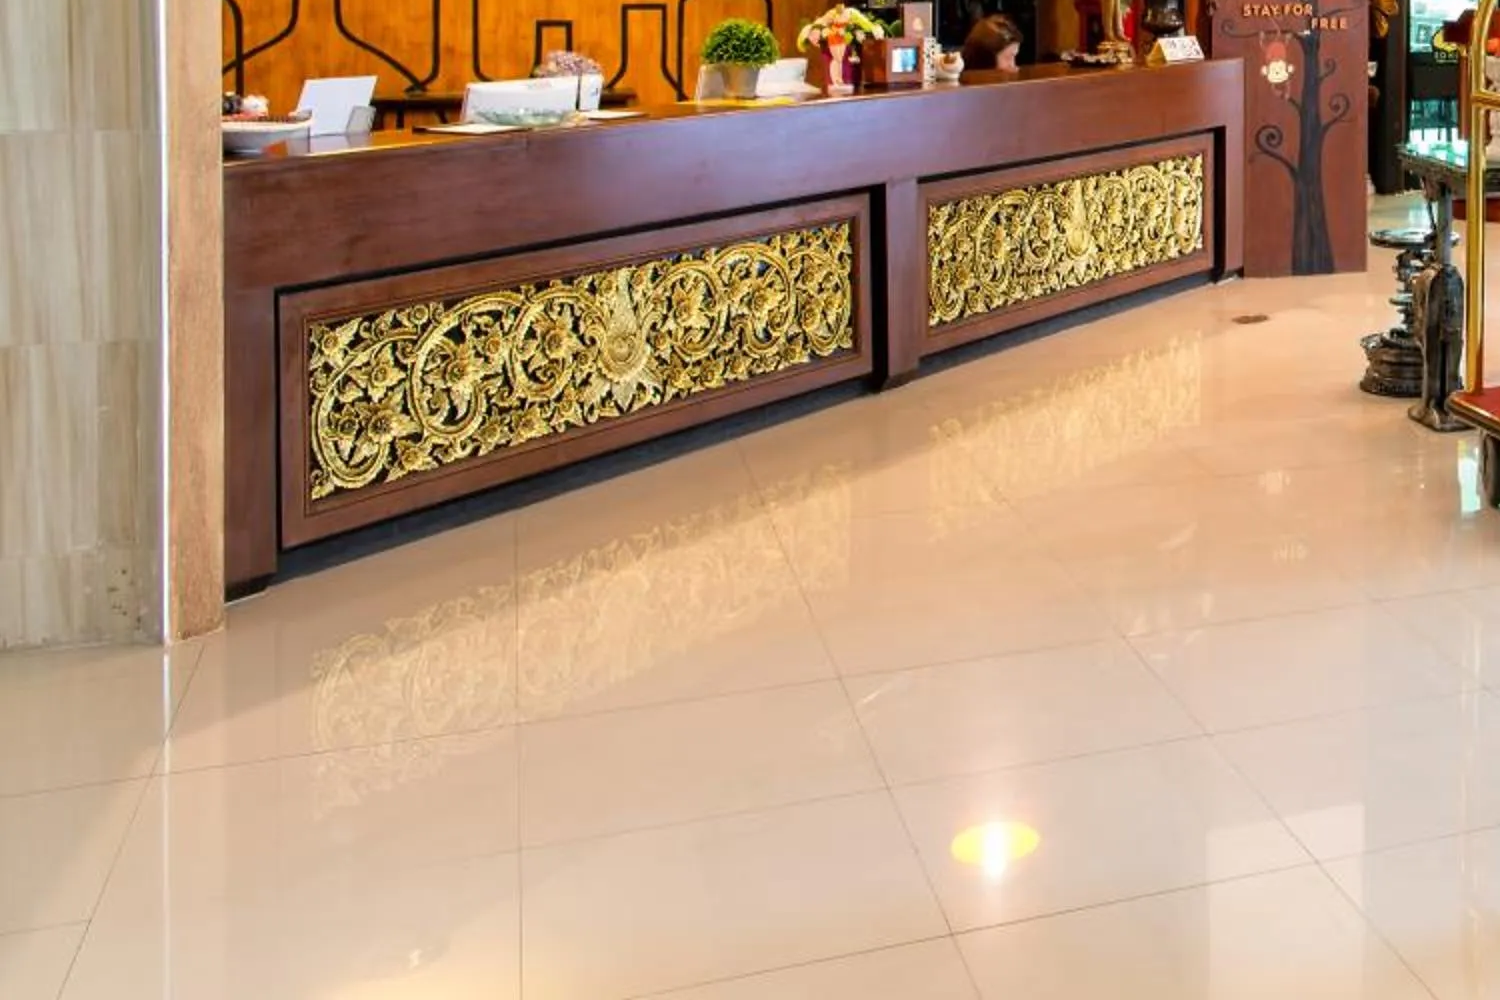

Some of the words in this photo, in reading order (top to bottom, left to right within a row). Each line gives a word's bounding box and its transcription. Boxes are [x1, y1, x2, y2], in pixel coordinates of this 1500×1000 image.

[1242, 3, 1280, 17] STAY
[1283, 3, 1313, 17] FOR
[1311, 17, 1348, 30] FREE
